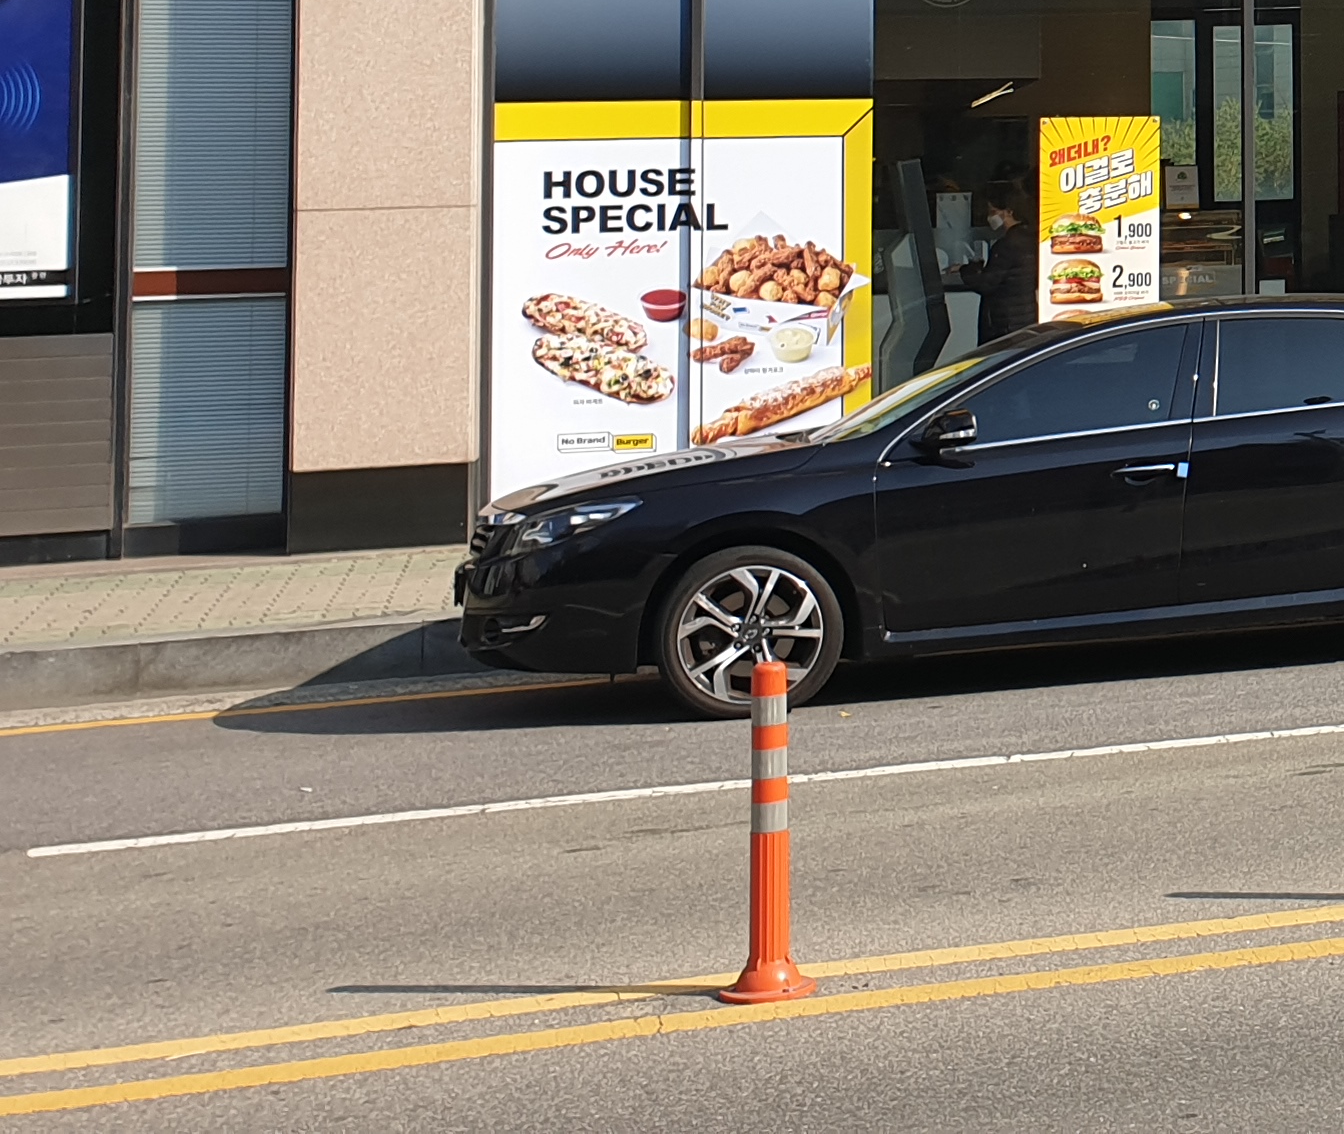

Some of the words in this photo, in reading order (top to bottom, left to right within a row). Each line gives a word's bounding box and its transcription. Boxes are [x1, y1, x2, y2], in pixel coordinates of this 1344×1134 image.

[1049, 135, 1112, 167] 왜더내?
[543, 168, 696, 199] HOUSE
[1059, 148, 1135, 193] 이걸로
[1078, 170, 1154, 215] 충분해
[542, 203, 729, 234] SPECIAL
[1113, 215, 1152, 241] 1,900
[545, 242, 601, 260] Only
[604, 239, 668, 257] Here!
[1112, 265, 1152, 289] 2,900
[1162, 275, 1214, 285] SPIAL
[561, 437, 575, 445] No
[576, 436, 606, 445] Brand
[616, 437, 649, 446] Burger
